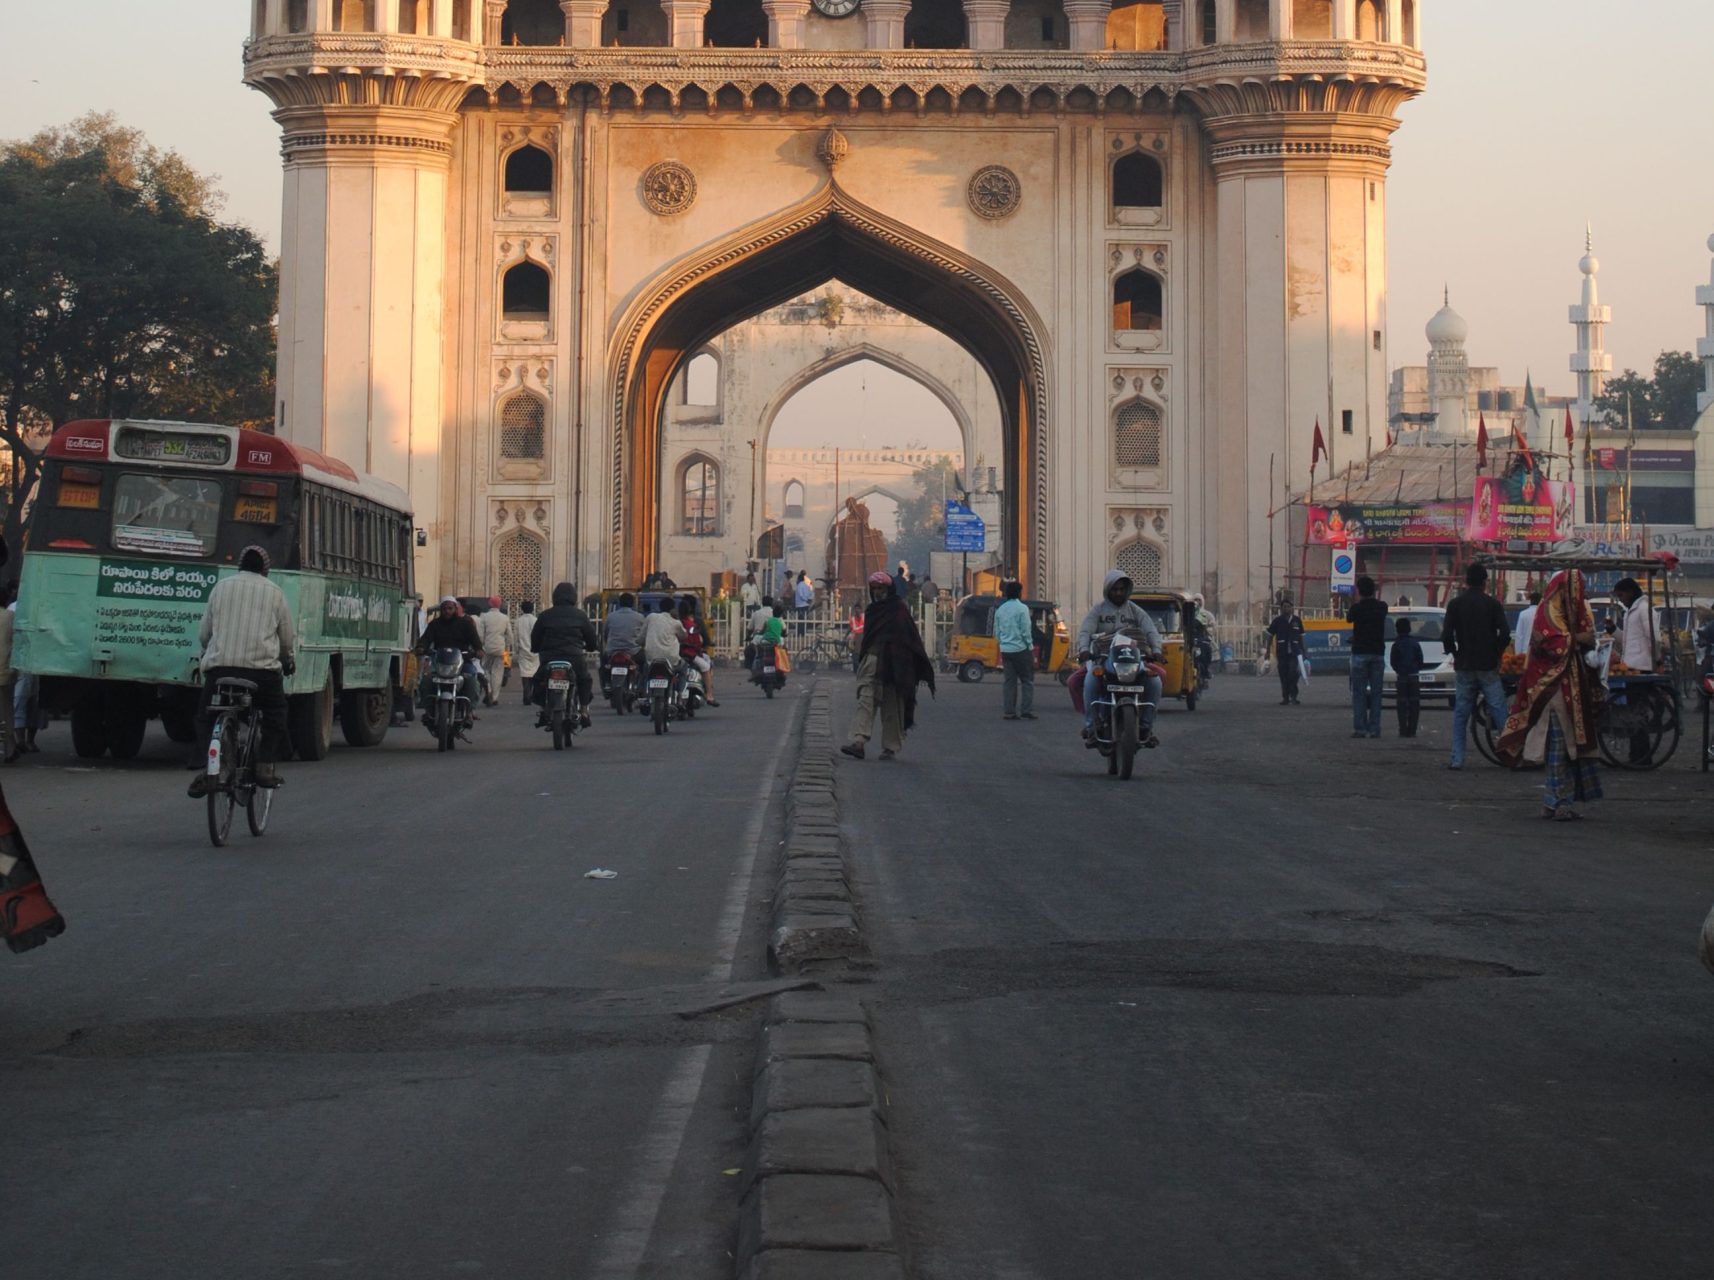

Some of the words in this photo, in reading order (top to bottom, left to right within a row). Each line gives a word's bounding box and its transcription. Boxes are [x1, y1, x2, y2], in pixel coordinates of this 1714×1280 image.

[165, 440, 185, 453] 532
[251, 453, 269, 462] FM
[64, 489, 97, 504] STOP
[1669, 532, 1701, 546] Ocean
[101, 565, 149, 580] రూపాయి
[150, 566, 175, 581] కిలో
[113, 581, 174, 597] నిరుపేదలకు
[176, 585, 202, 598] వరం
